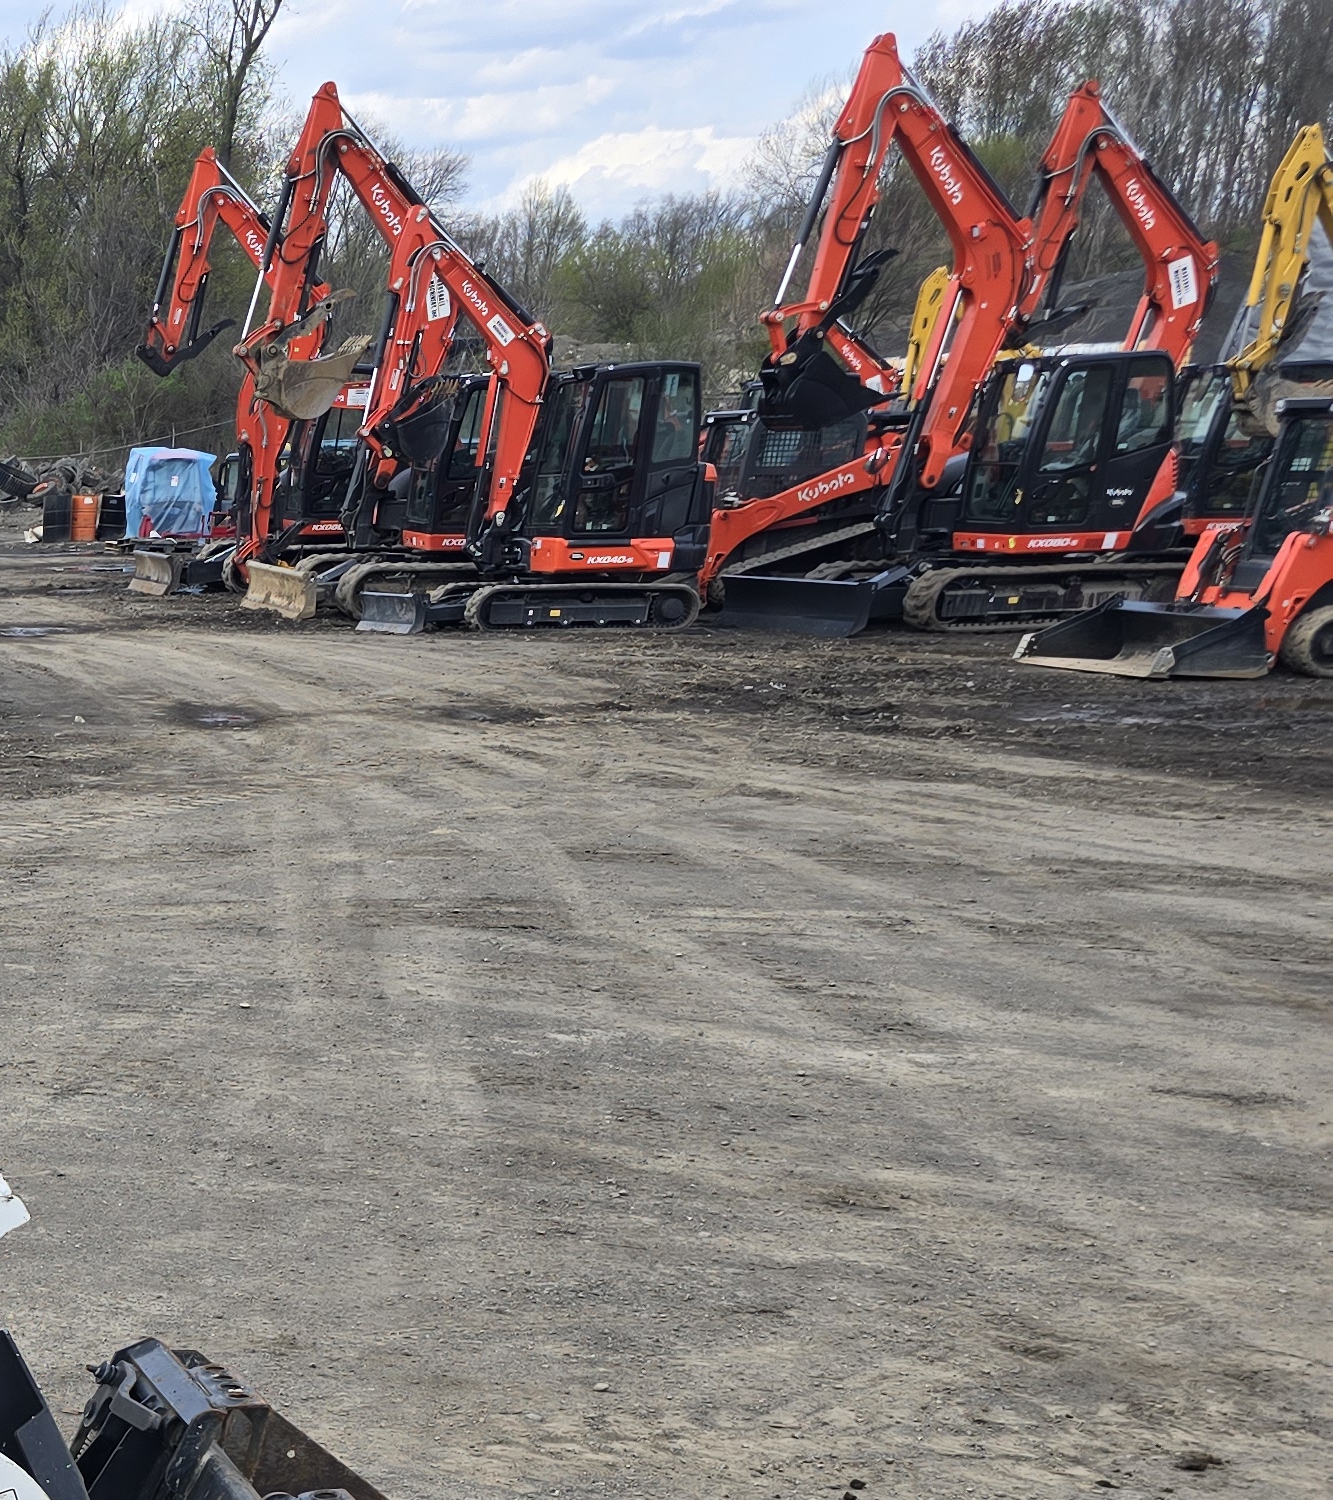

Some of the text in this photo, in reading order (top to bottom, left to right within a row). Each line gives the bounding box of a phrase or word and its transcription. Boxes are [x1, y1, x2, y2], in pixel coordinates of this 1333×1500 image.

[930, 145, 964, 206] Kubota
[371, 182, 403, 236] Kubota
[1126, 177, 1156, 231] Kubota
[462, 279, 489, 317] Kubota
[797, 472, 856, 502] Kubota
